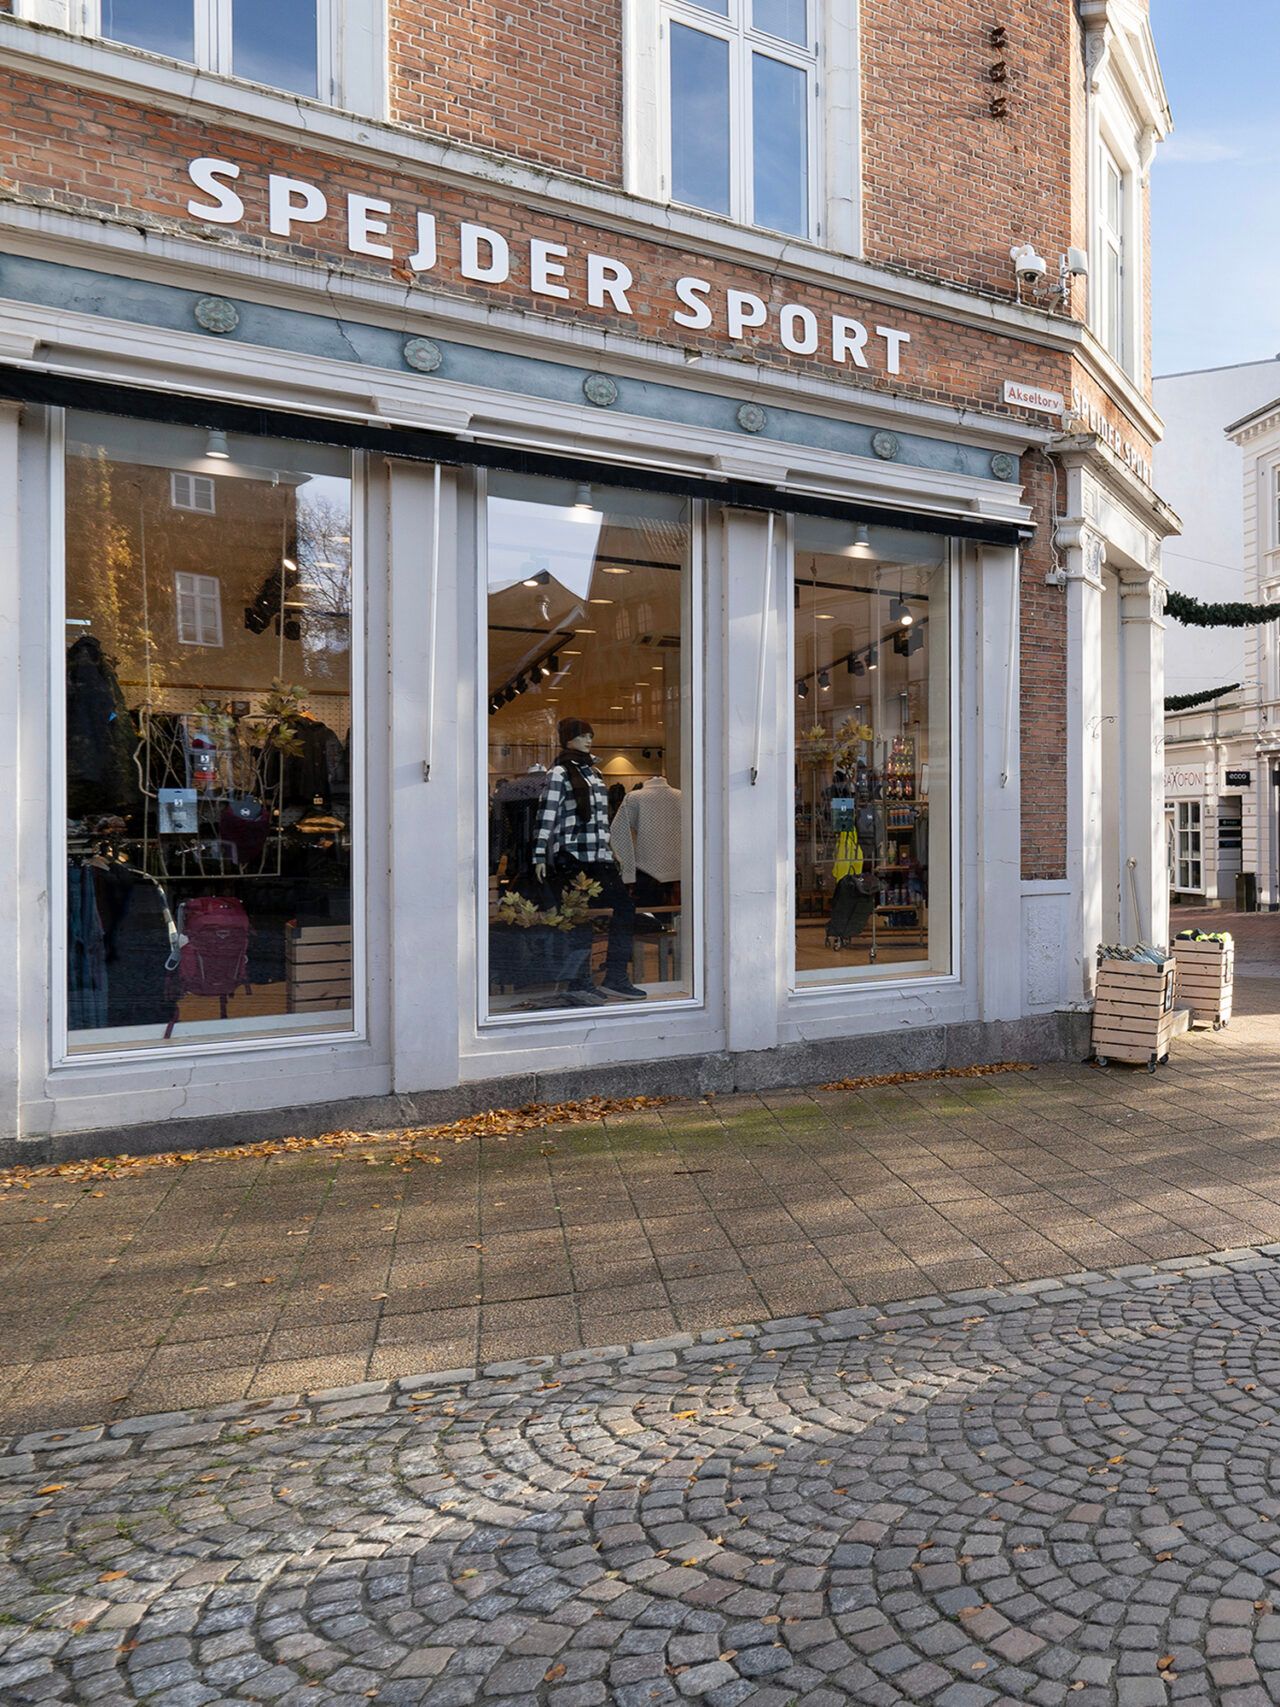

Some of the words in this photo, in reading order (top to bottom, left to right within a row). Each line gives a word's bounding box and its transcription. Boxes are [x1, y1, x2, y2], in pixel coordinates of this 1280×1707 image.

[187, 157, 633, 315] SPEJDER
[673, 276, 911, 375] SPORT
[1008, 387, 1059, 409] Akseltorv
